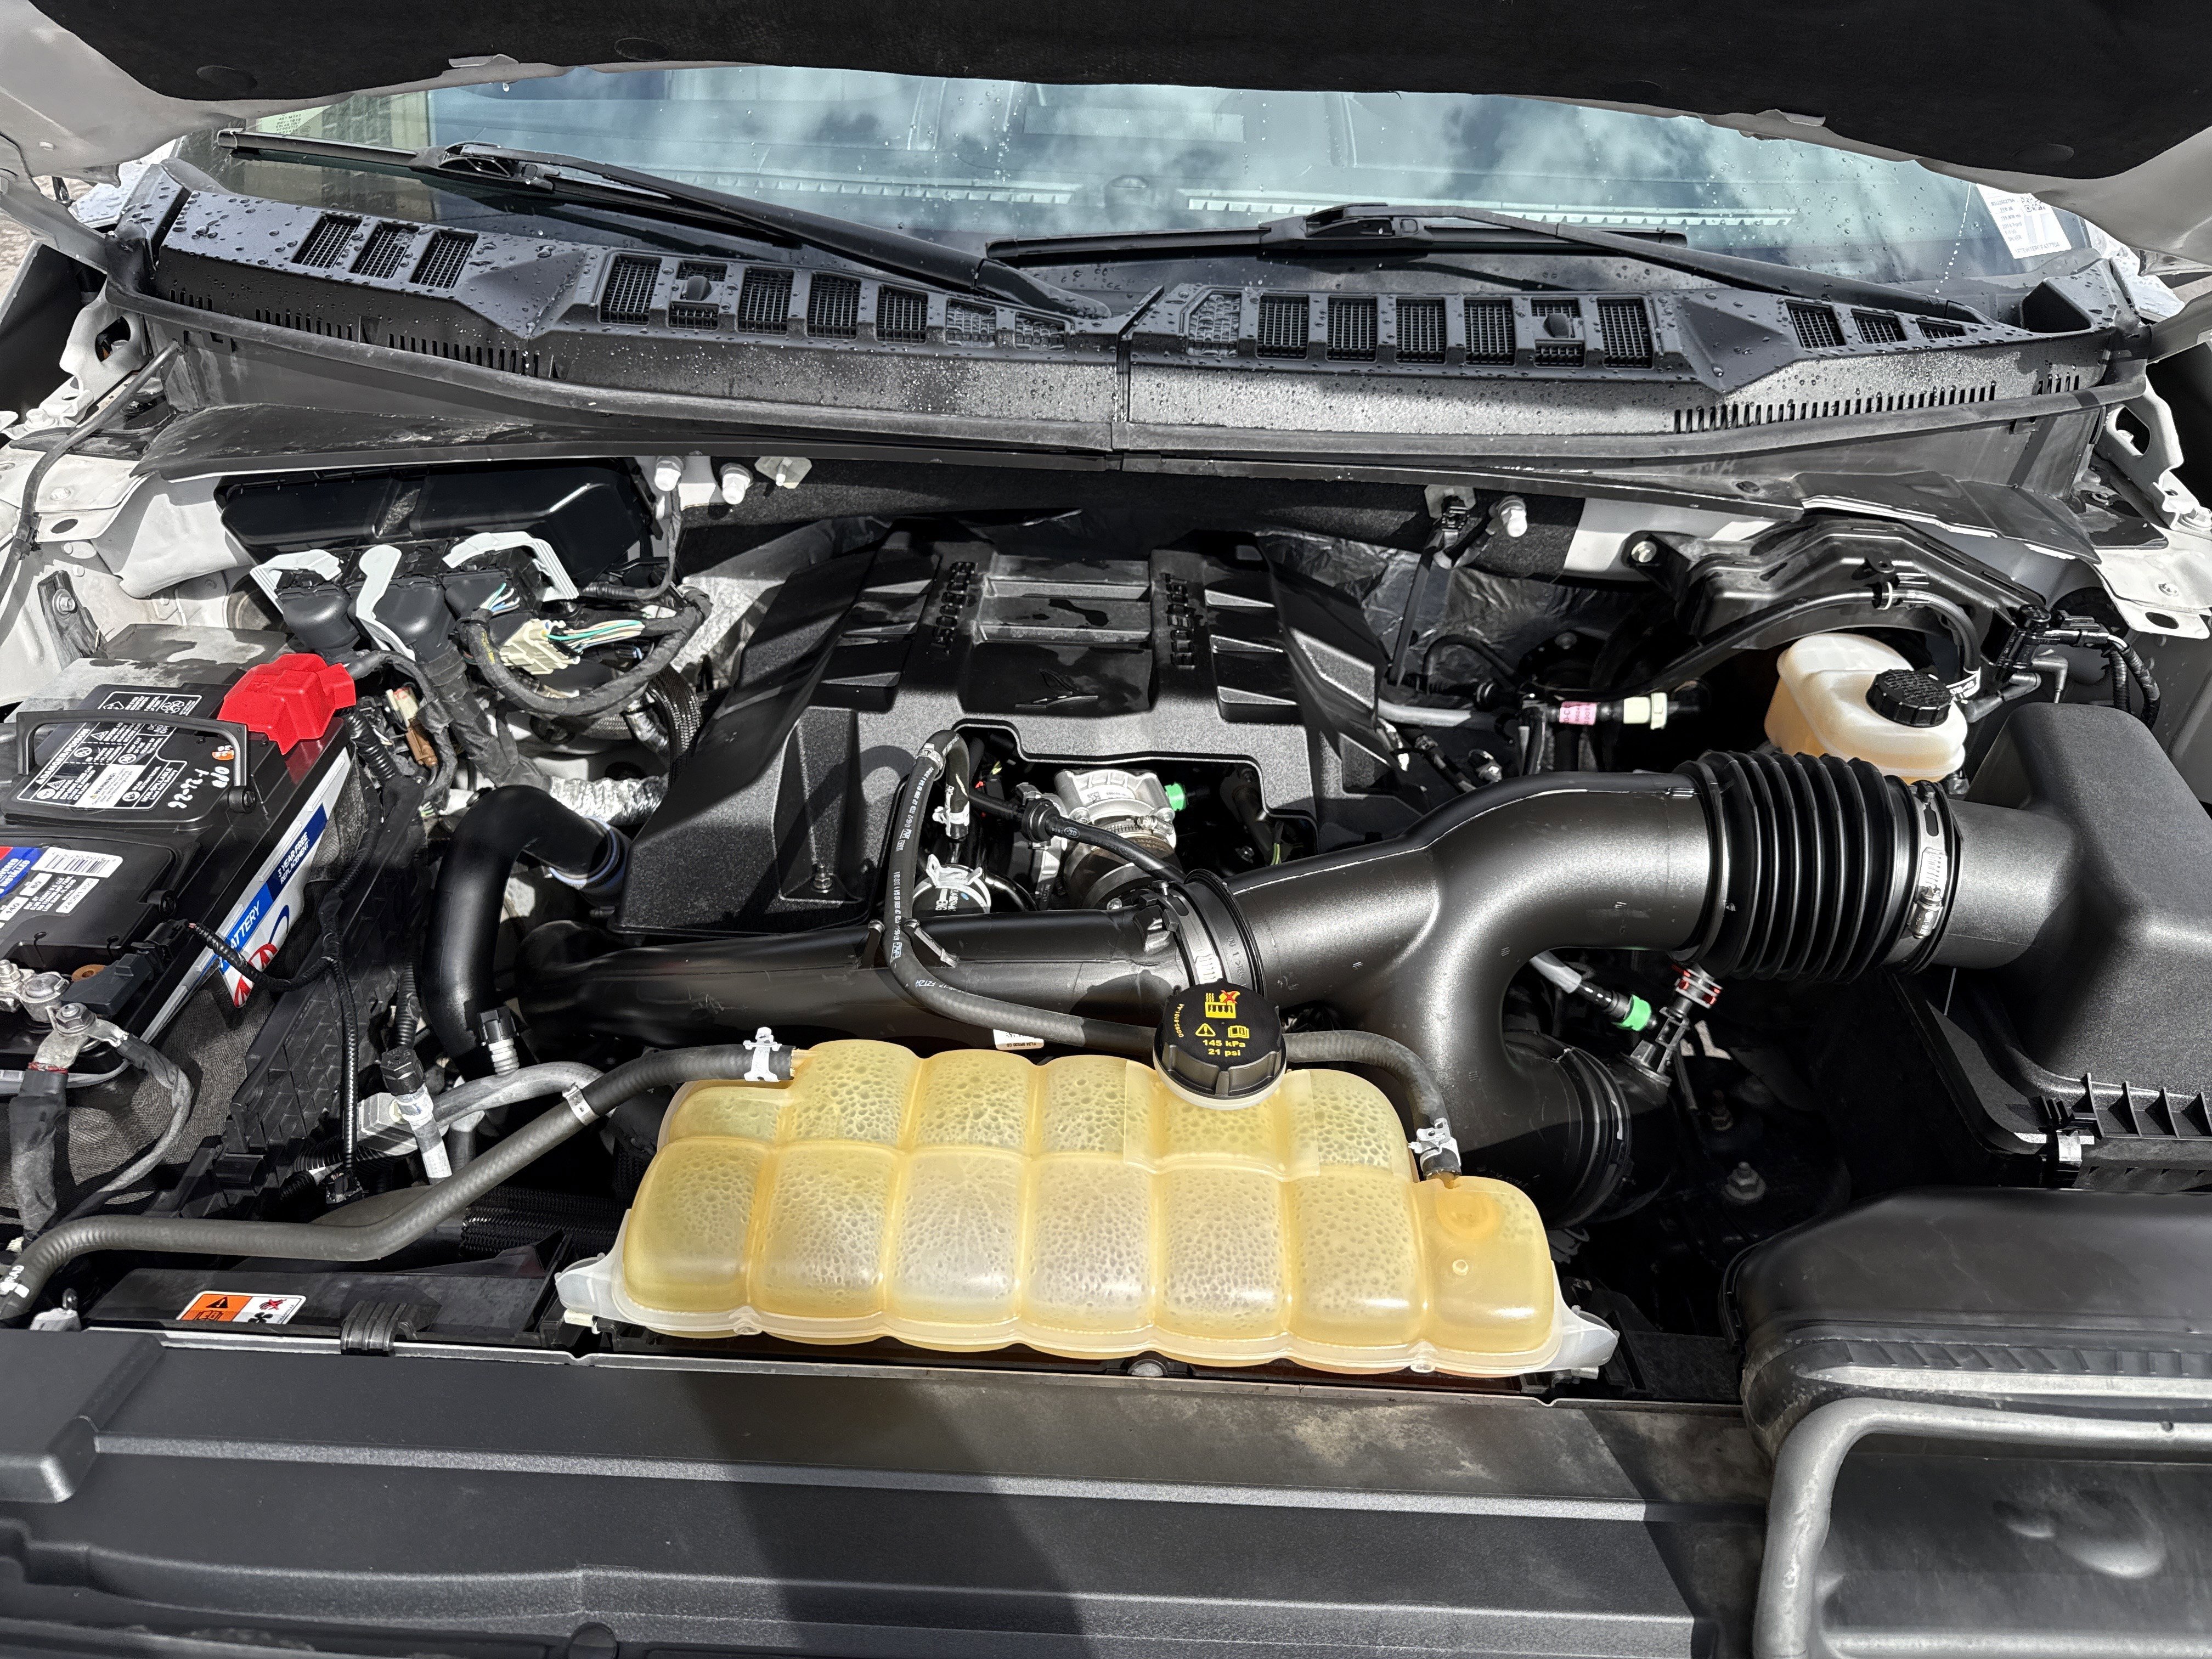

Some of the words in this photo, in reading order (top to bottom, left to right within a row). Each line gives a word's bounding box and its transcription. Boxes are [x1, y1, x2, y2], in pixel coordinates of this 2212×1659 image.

[38, 729, 91, 779] DANGER/POISON
[278, 868, 281, 877] 3
[281, 850, 295, 872] YEAR
[295, 831, 308, 854] FREE
[935, 900, 948, 911] ENG
[230, 900, 259, 949] ATTERY
[1224, 1048, 1241, 1057] psi
[1225, 1039, 1246, 1047] kPa
